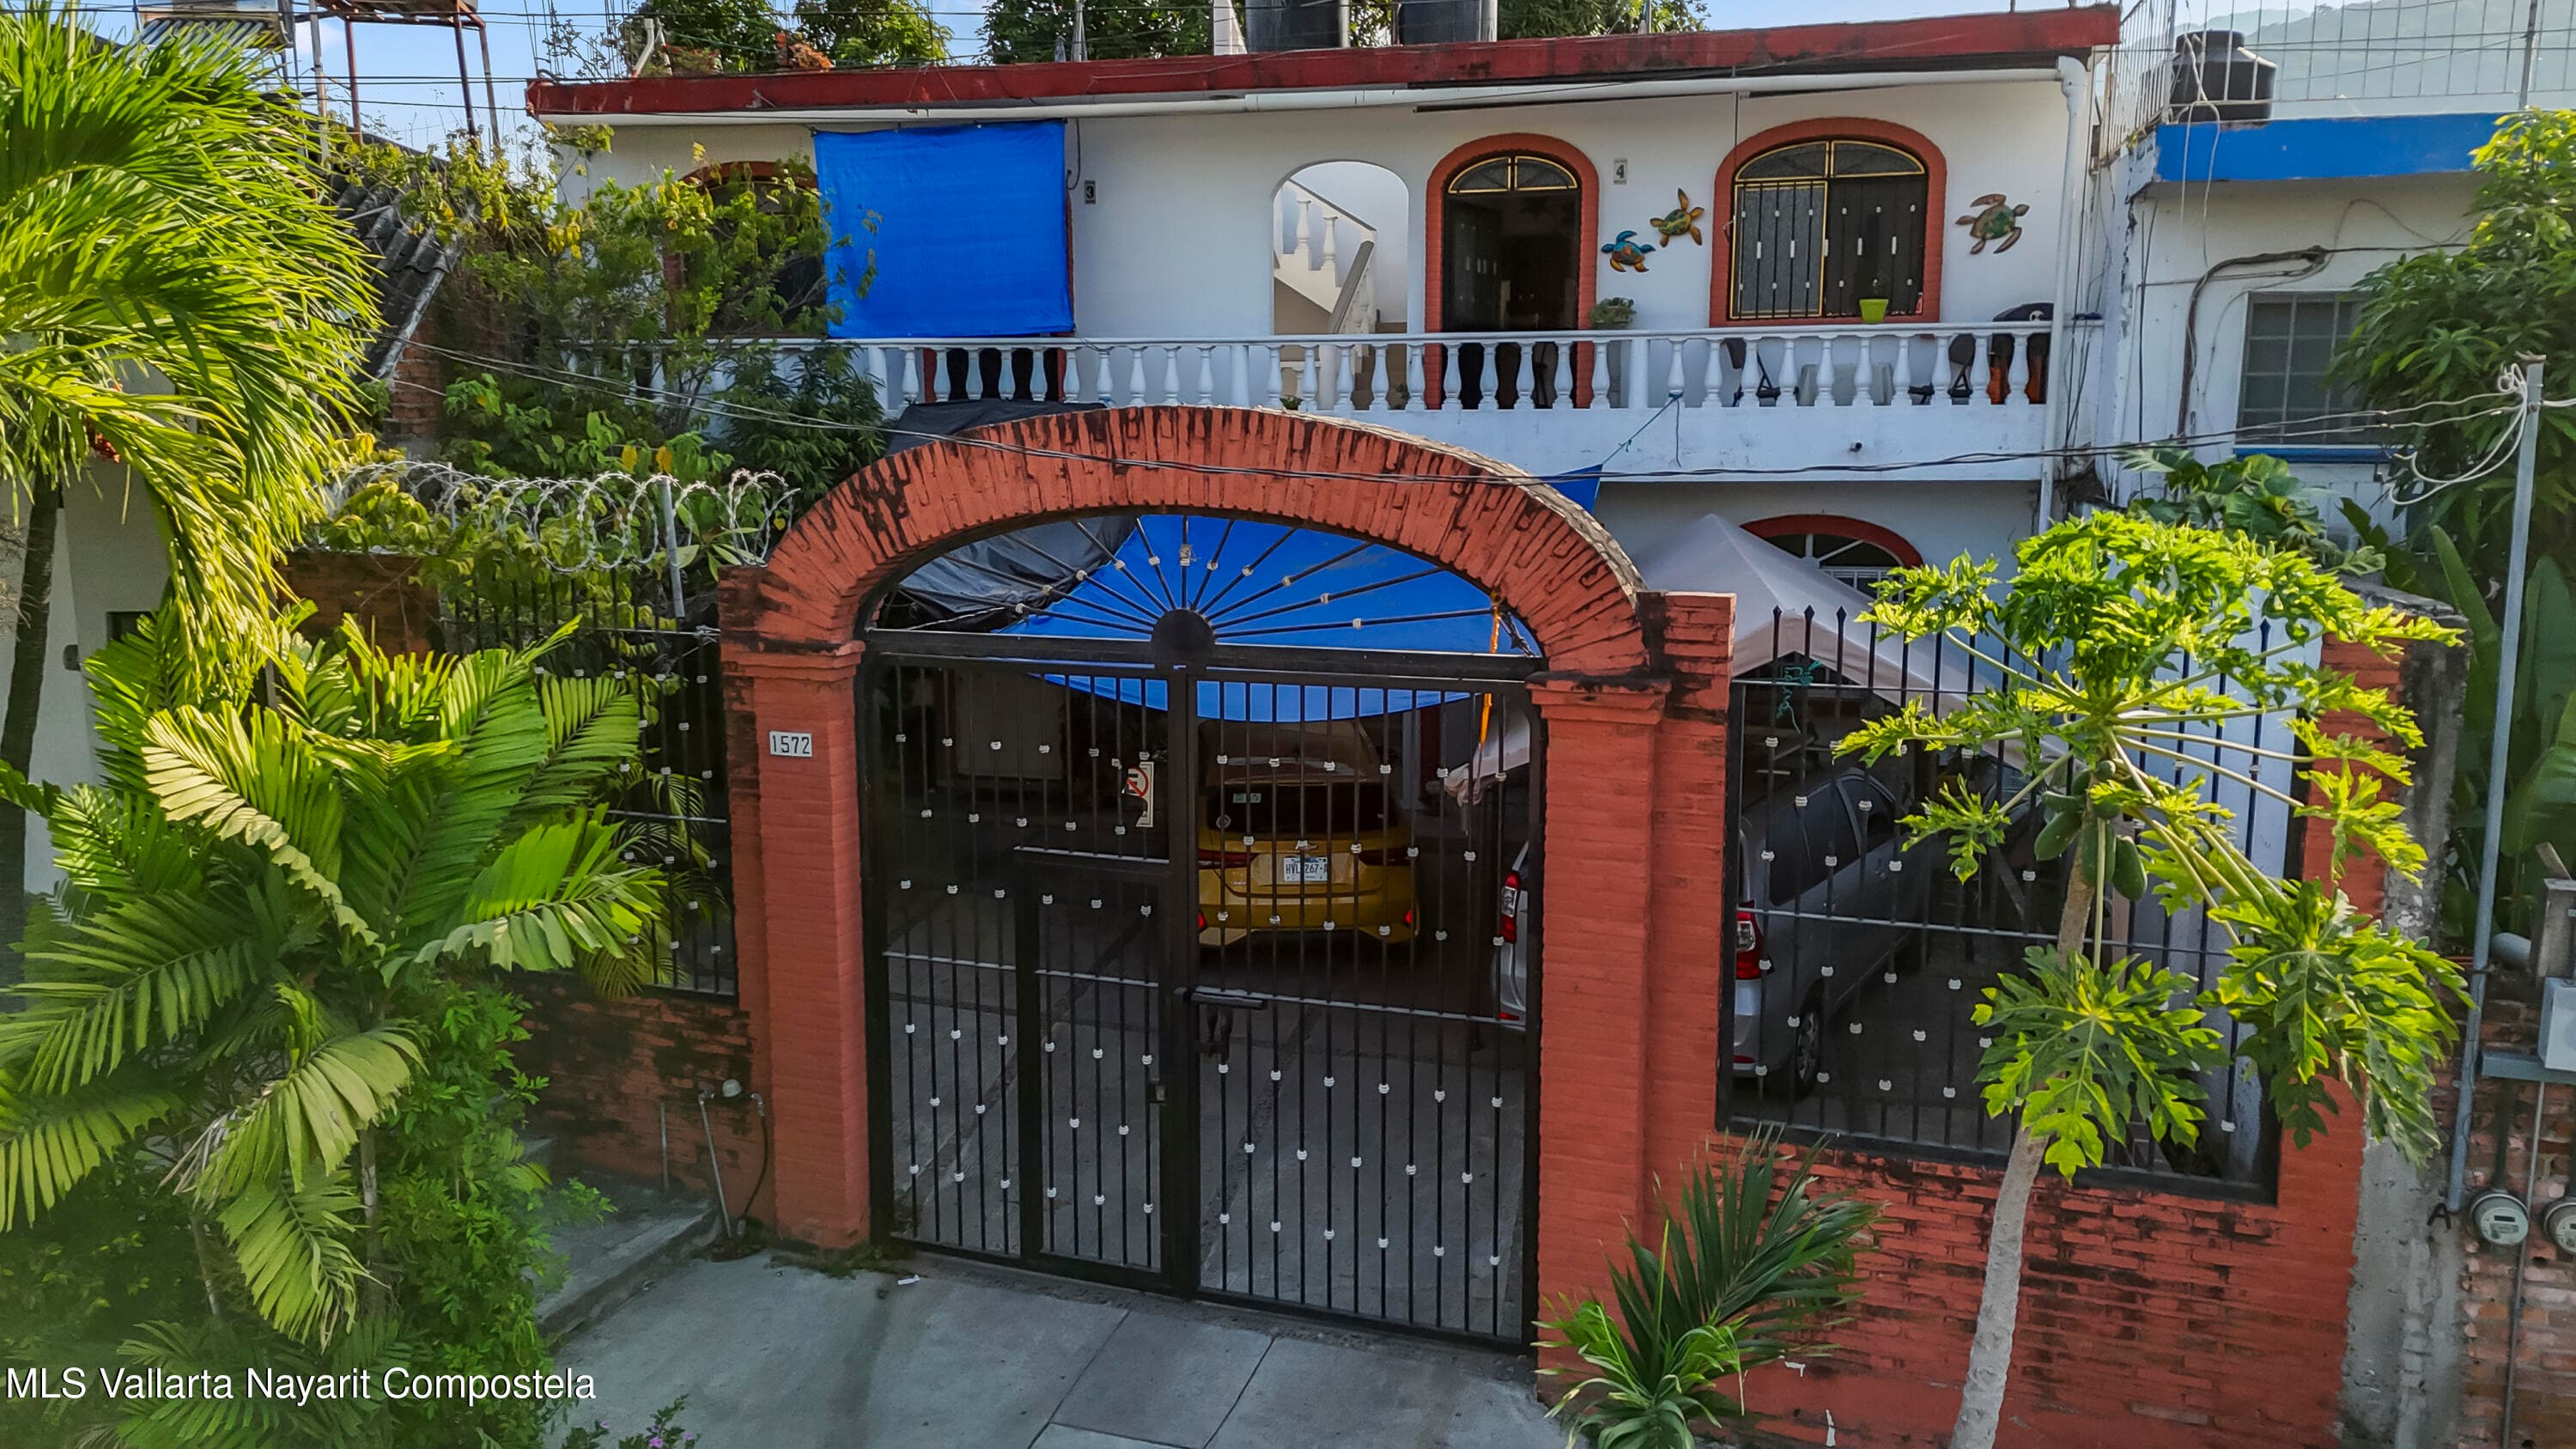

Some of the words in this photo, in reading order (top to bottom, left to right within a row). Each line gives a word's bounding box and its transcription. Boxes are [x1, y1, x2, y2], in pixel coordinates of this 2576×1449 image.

[1616, 164, 1625, 179] 4
[1086, 186, 1094, 198] 3
[773, 734, 811, 754] 1572
